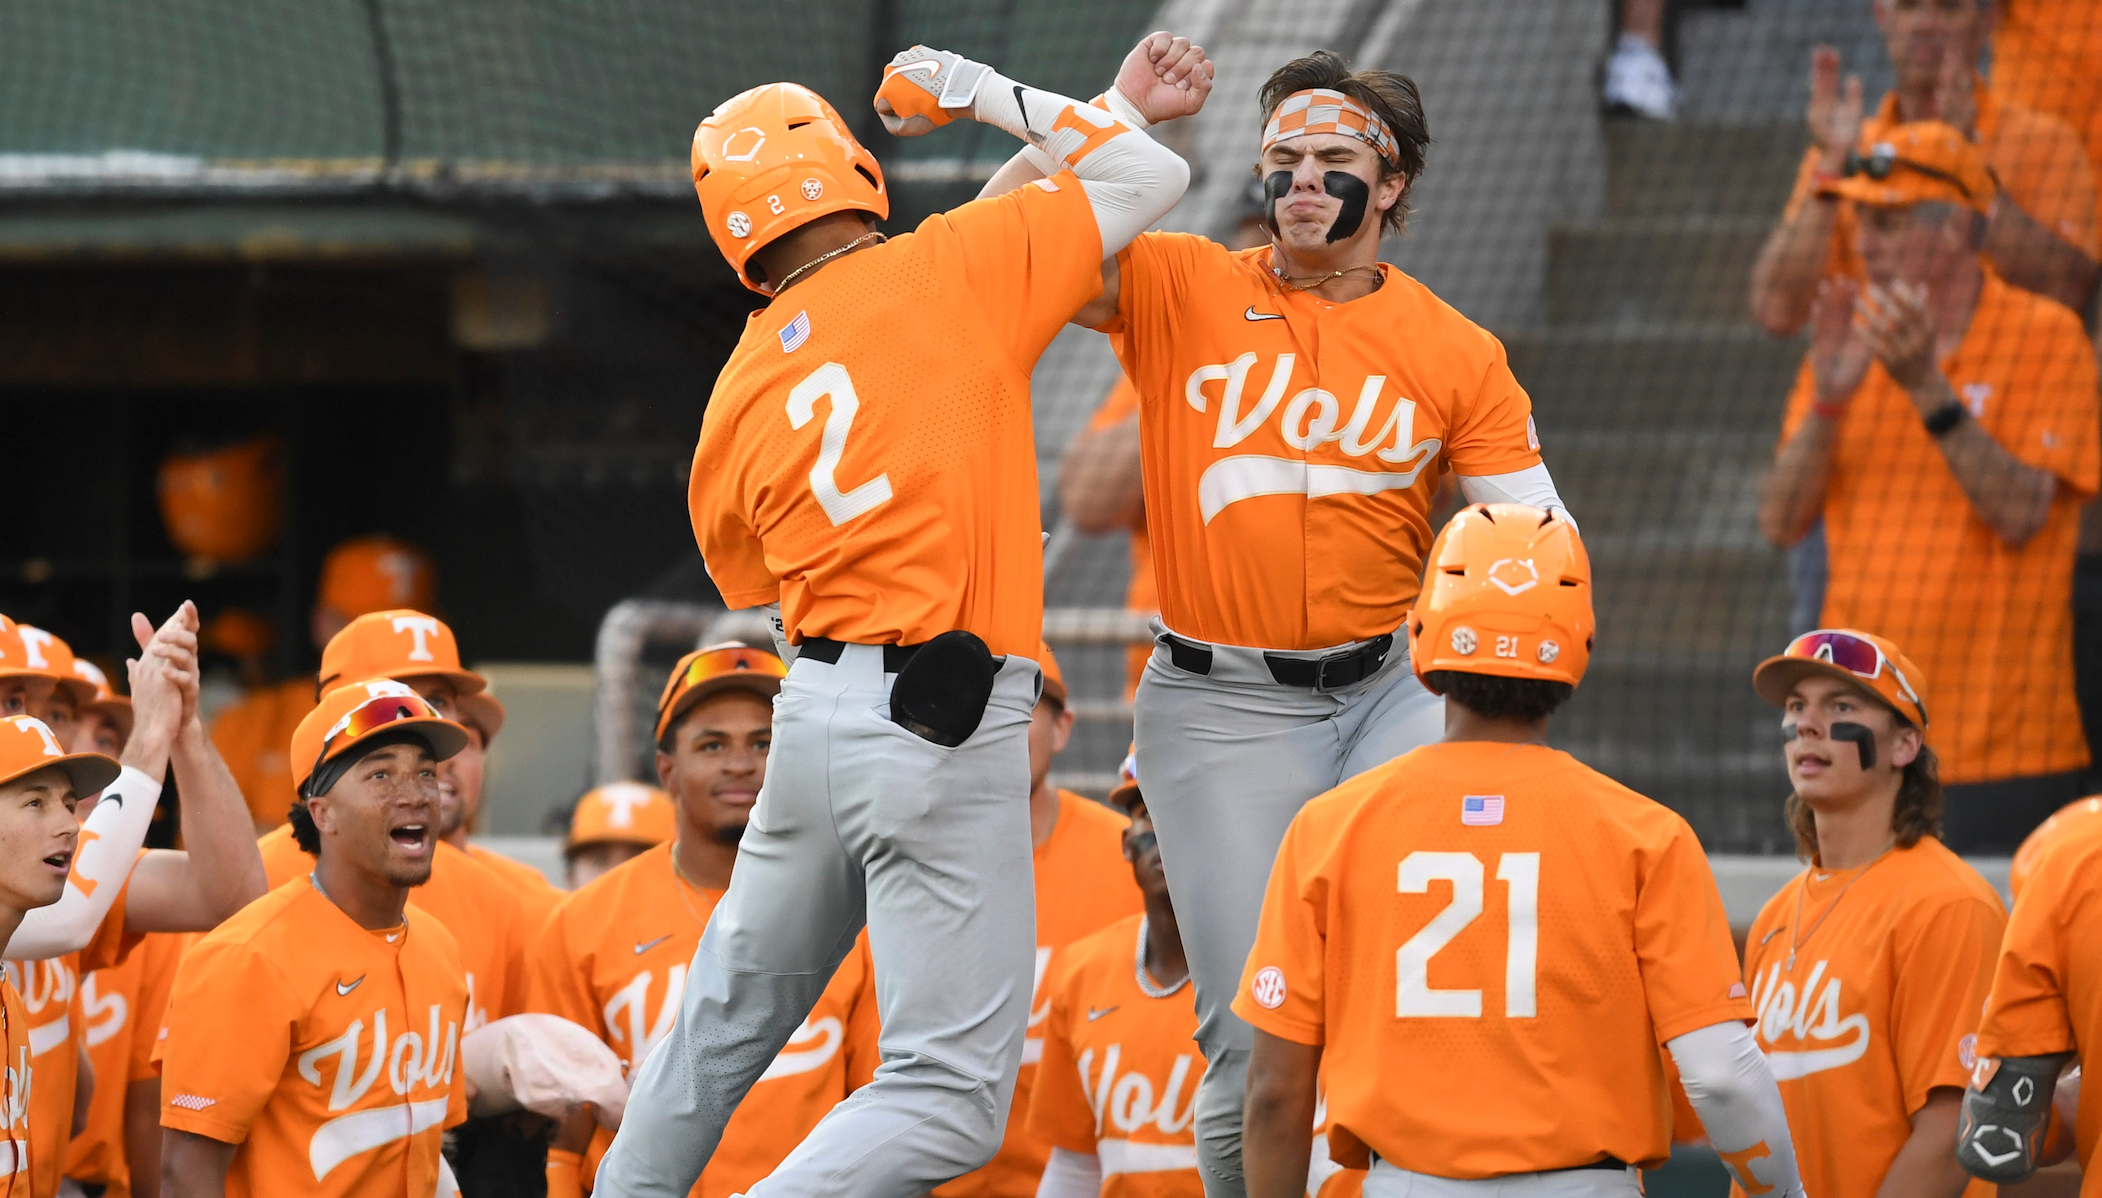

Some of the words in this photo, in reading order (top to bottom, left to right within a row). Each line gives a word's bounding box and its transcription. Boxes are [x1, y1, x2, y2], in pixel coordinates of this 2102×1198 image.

[767, 195, 785, 215] 2
[1184, 352, 1442, 463] Vols
[785, 361, 893, 528] 2
[392, 617, 438, 662] T
[1495, 636, 1518, 657] 21
[14, 718, 62, 757] T
[1396, 851, 1540, 1018] 21
[1254, 968, 1286, 1007] SEC
